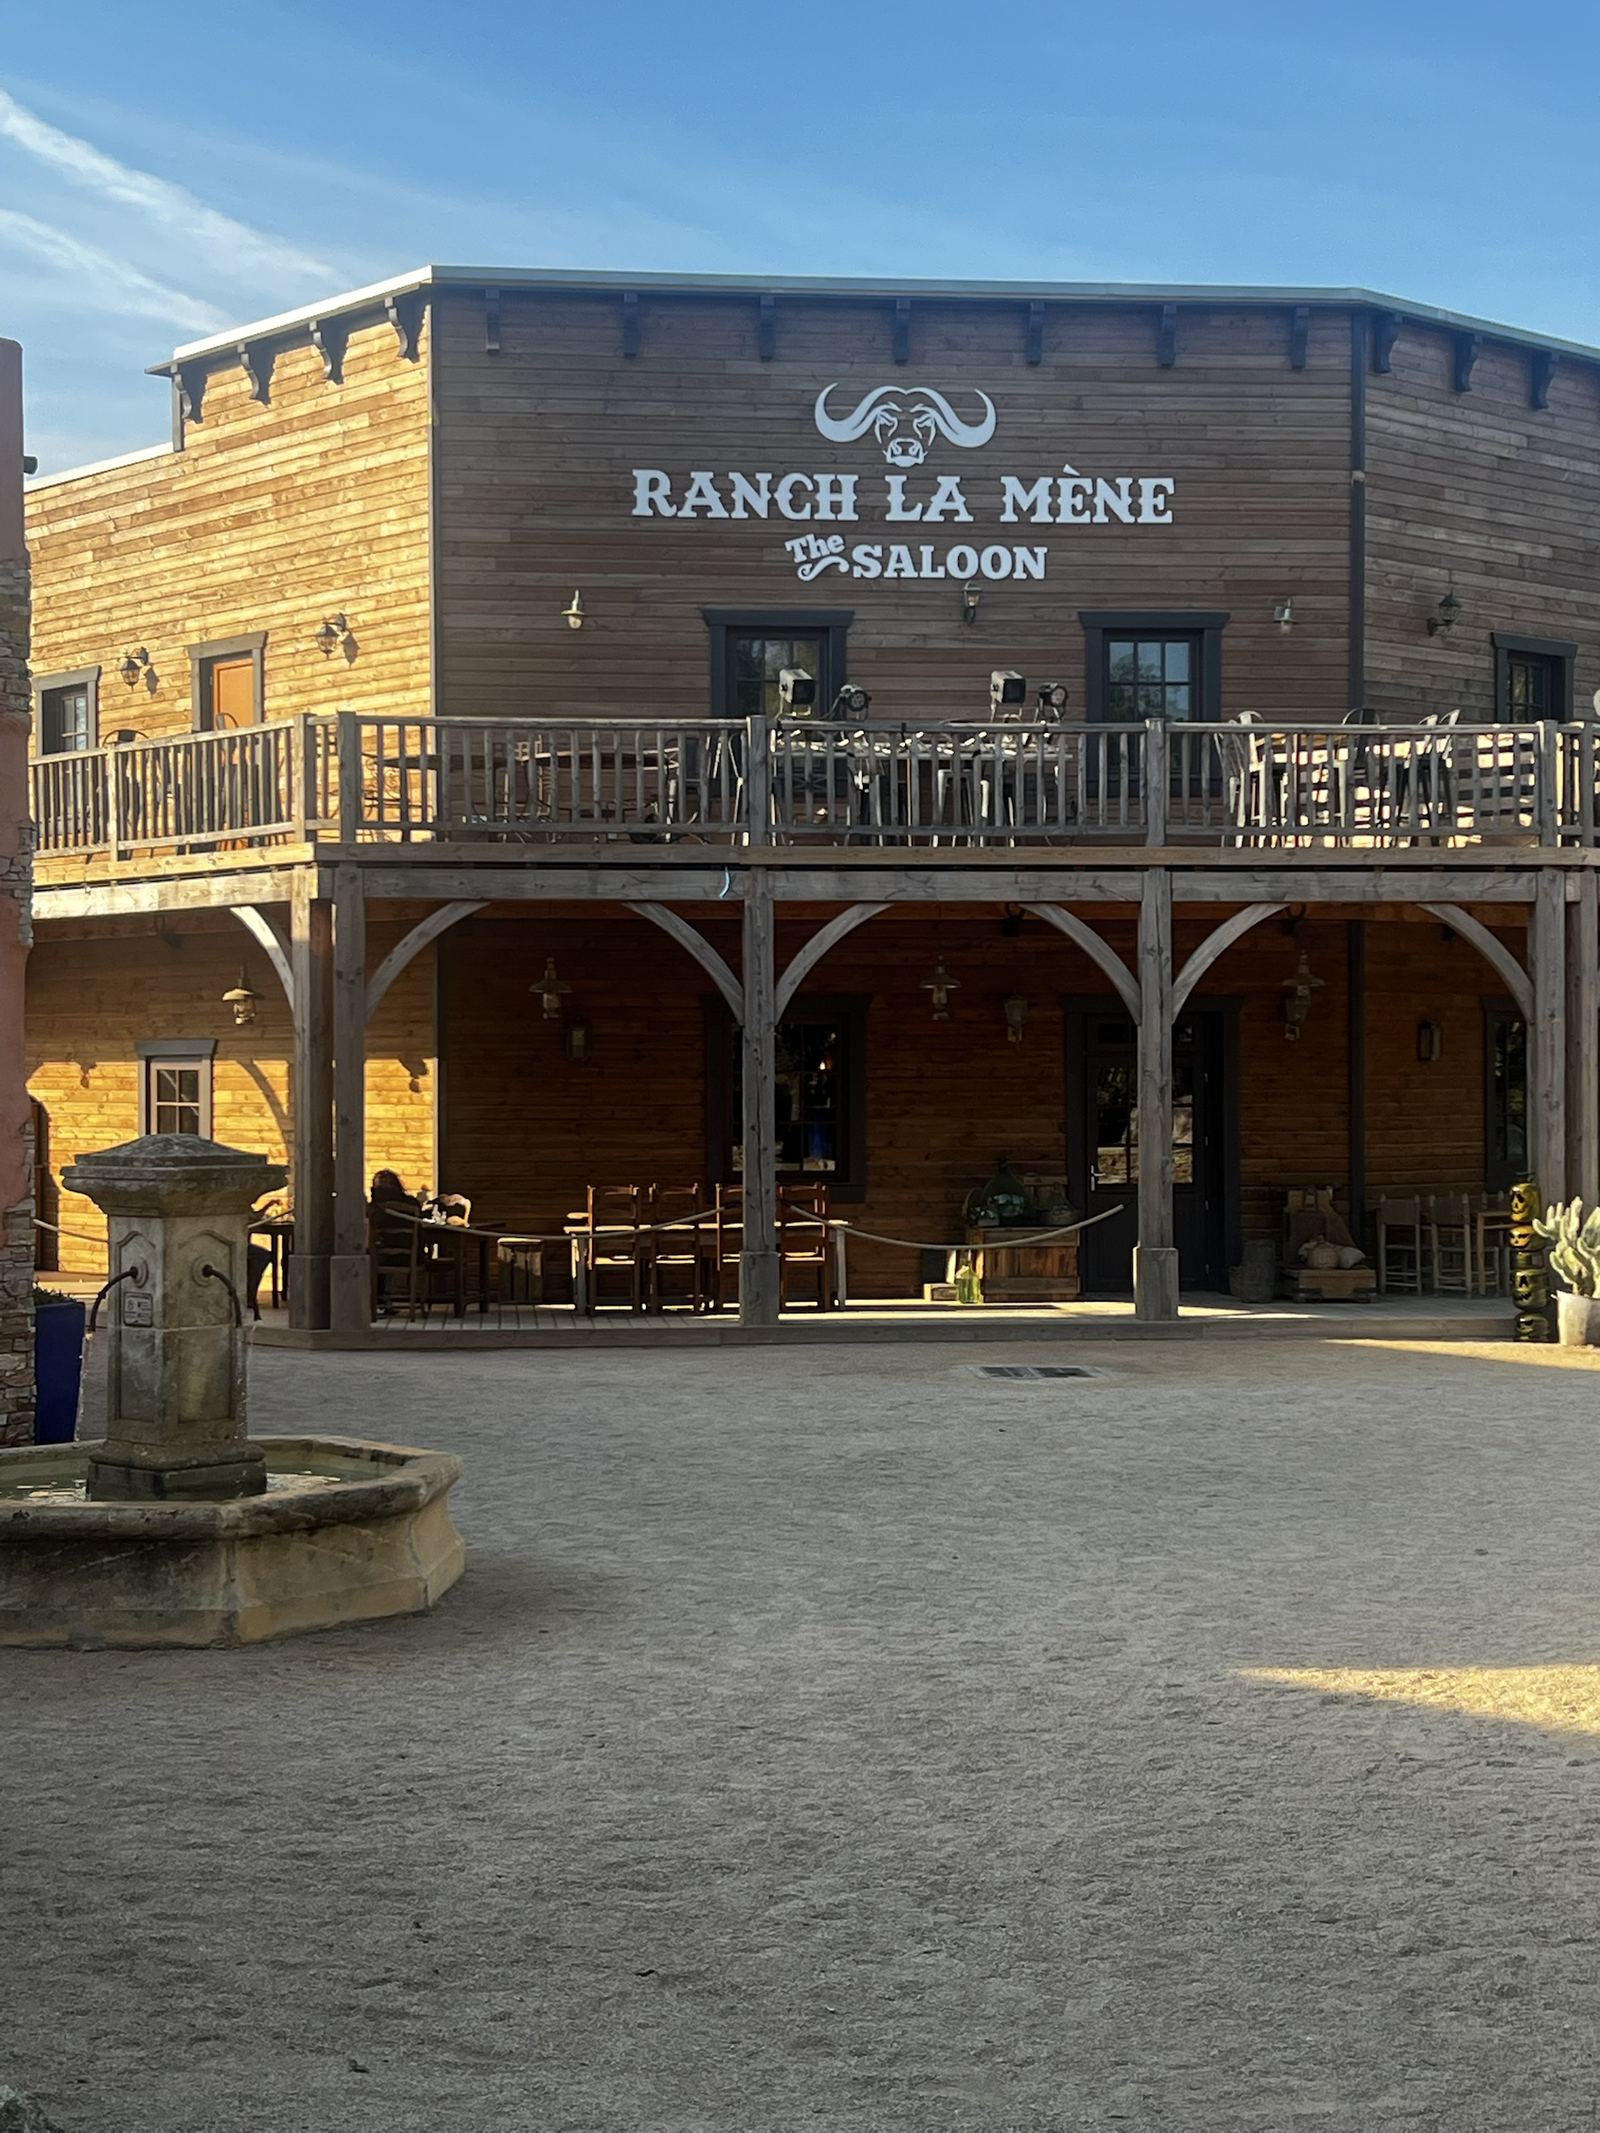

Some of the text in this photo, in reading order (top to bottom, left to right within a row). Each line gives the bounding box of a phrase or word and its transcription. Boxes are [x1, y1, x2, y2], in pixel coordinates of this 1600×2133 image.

[631, 463, 1176, 524] RANCH LA MÈNE
[784, 533, 1049, 580] The SALOON
